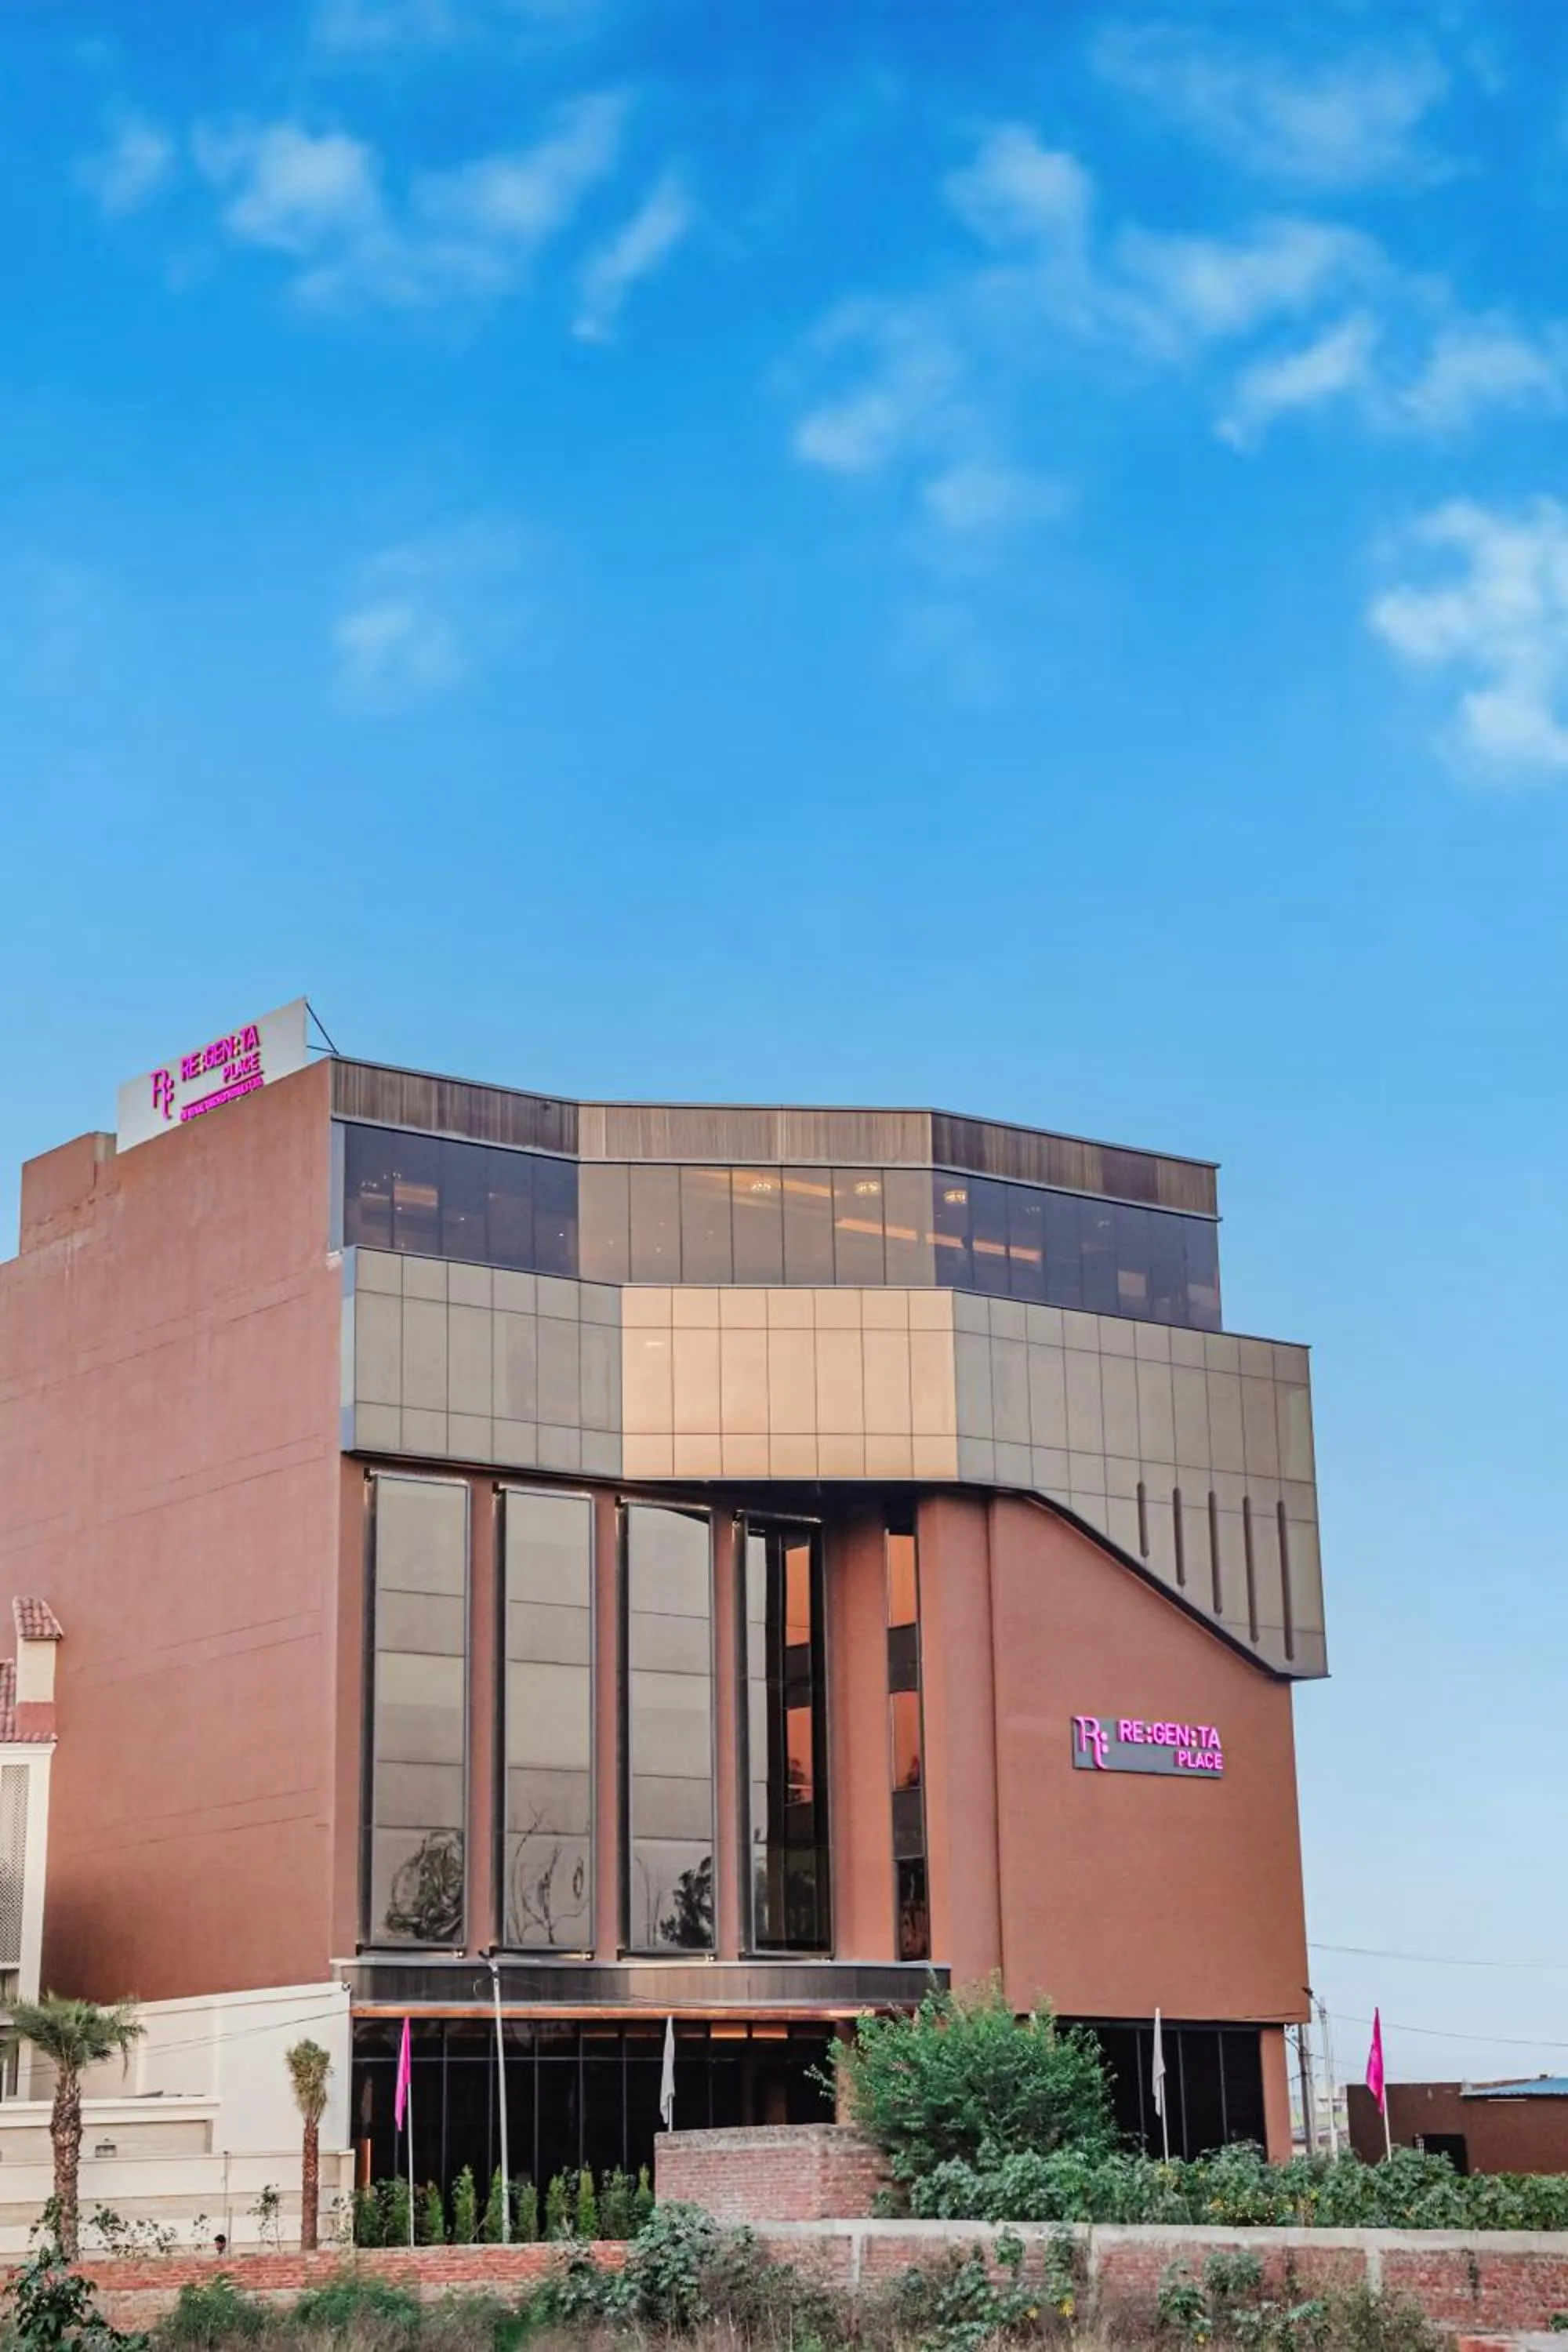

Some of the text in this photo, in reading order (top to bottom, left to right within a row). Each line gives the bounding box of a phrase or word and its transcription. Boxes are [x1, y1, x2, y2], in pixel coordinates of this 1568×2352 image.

[222, 1051, 261, 1083] PLACE
[1119, 1719, 1221, 1749] RE:GEN:TA
[1177, 1749, 1223, 1769] PLACE
